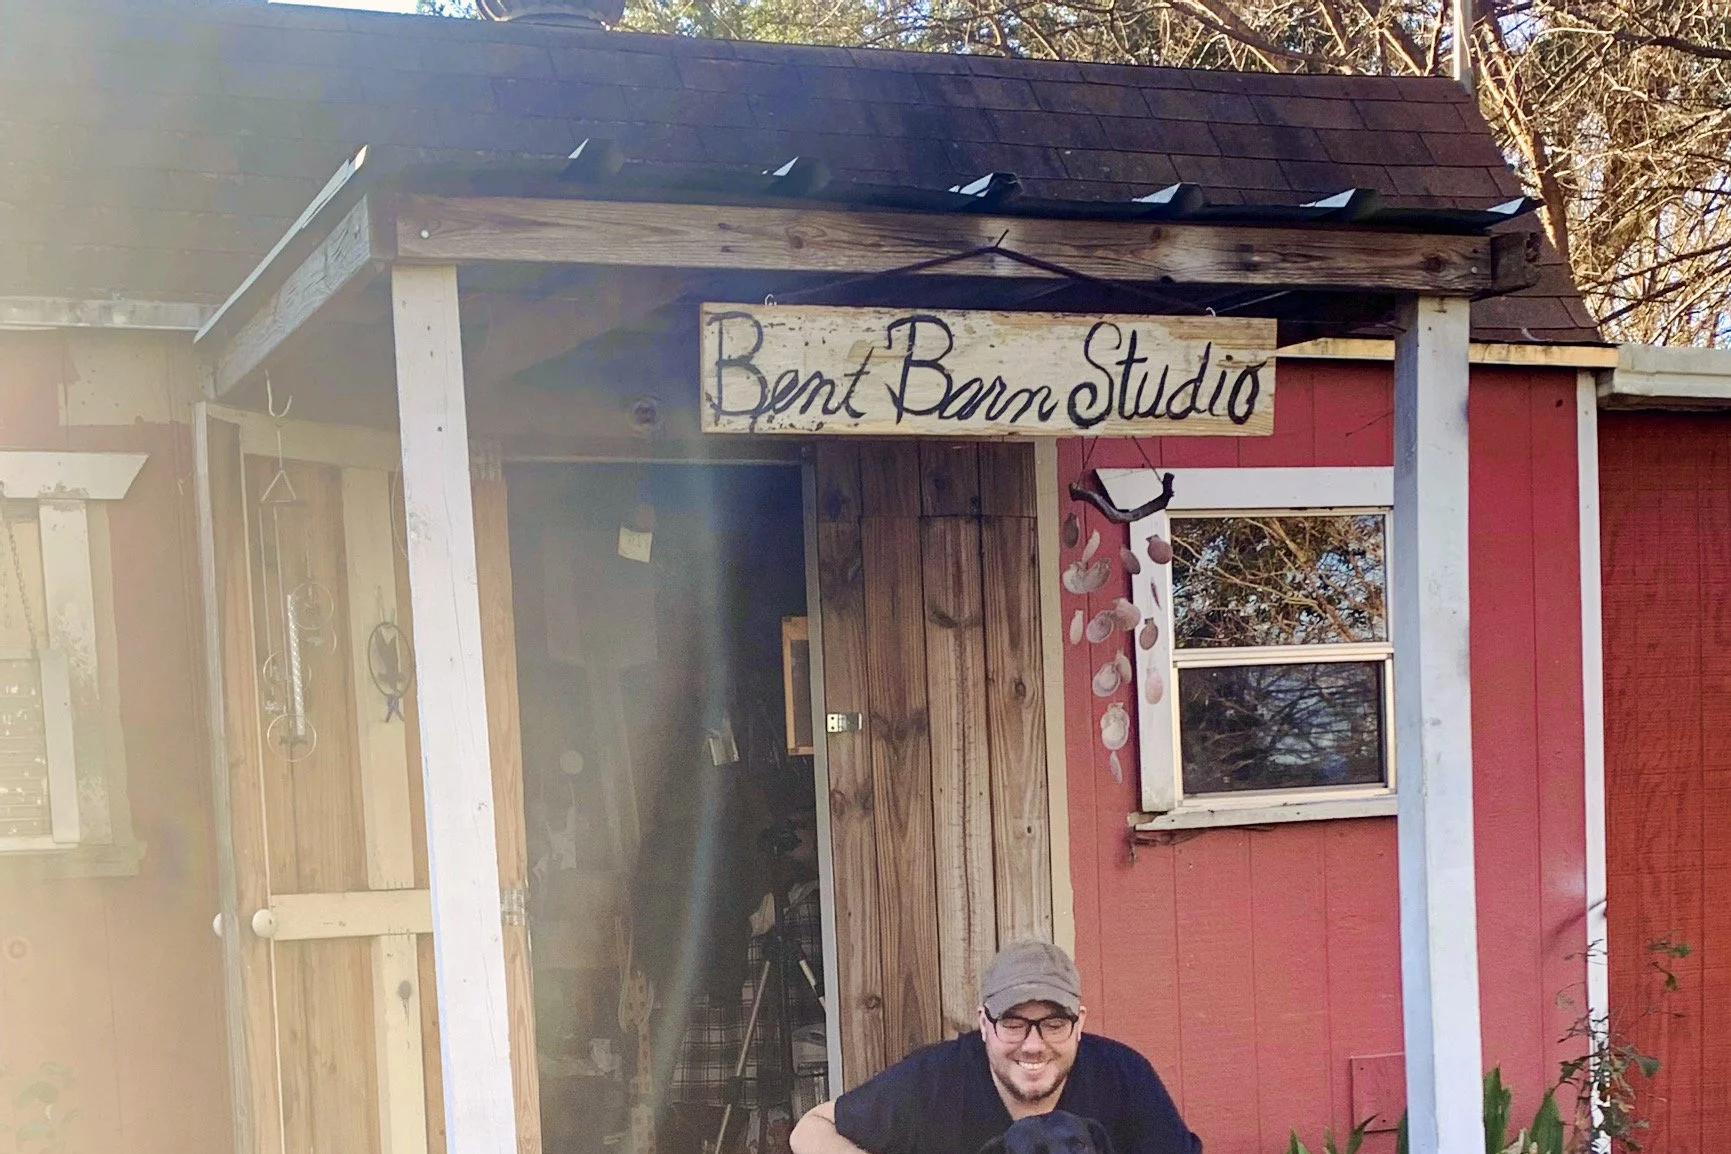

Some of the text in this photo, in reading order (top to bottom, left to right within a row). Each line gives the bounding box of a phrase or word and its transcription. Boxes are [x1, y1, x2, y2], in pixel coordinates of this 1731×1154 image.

[705, 311, 1268, 429] Bent Barn Studio
